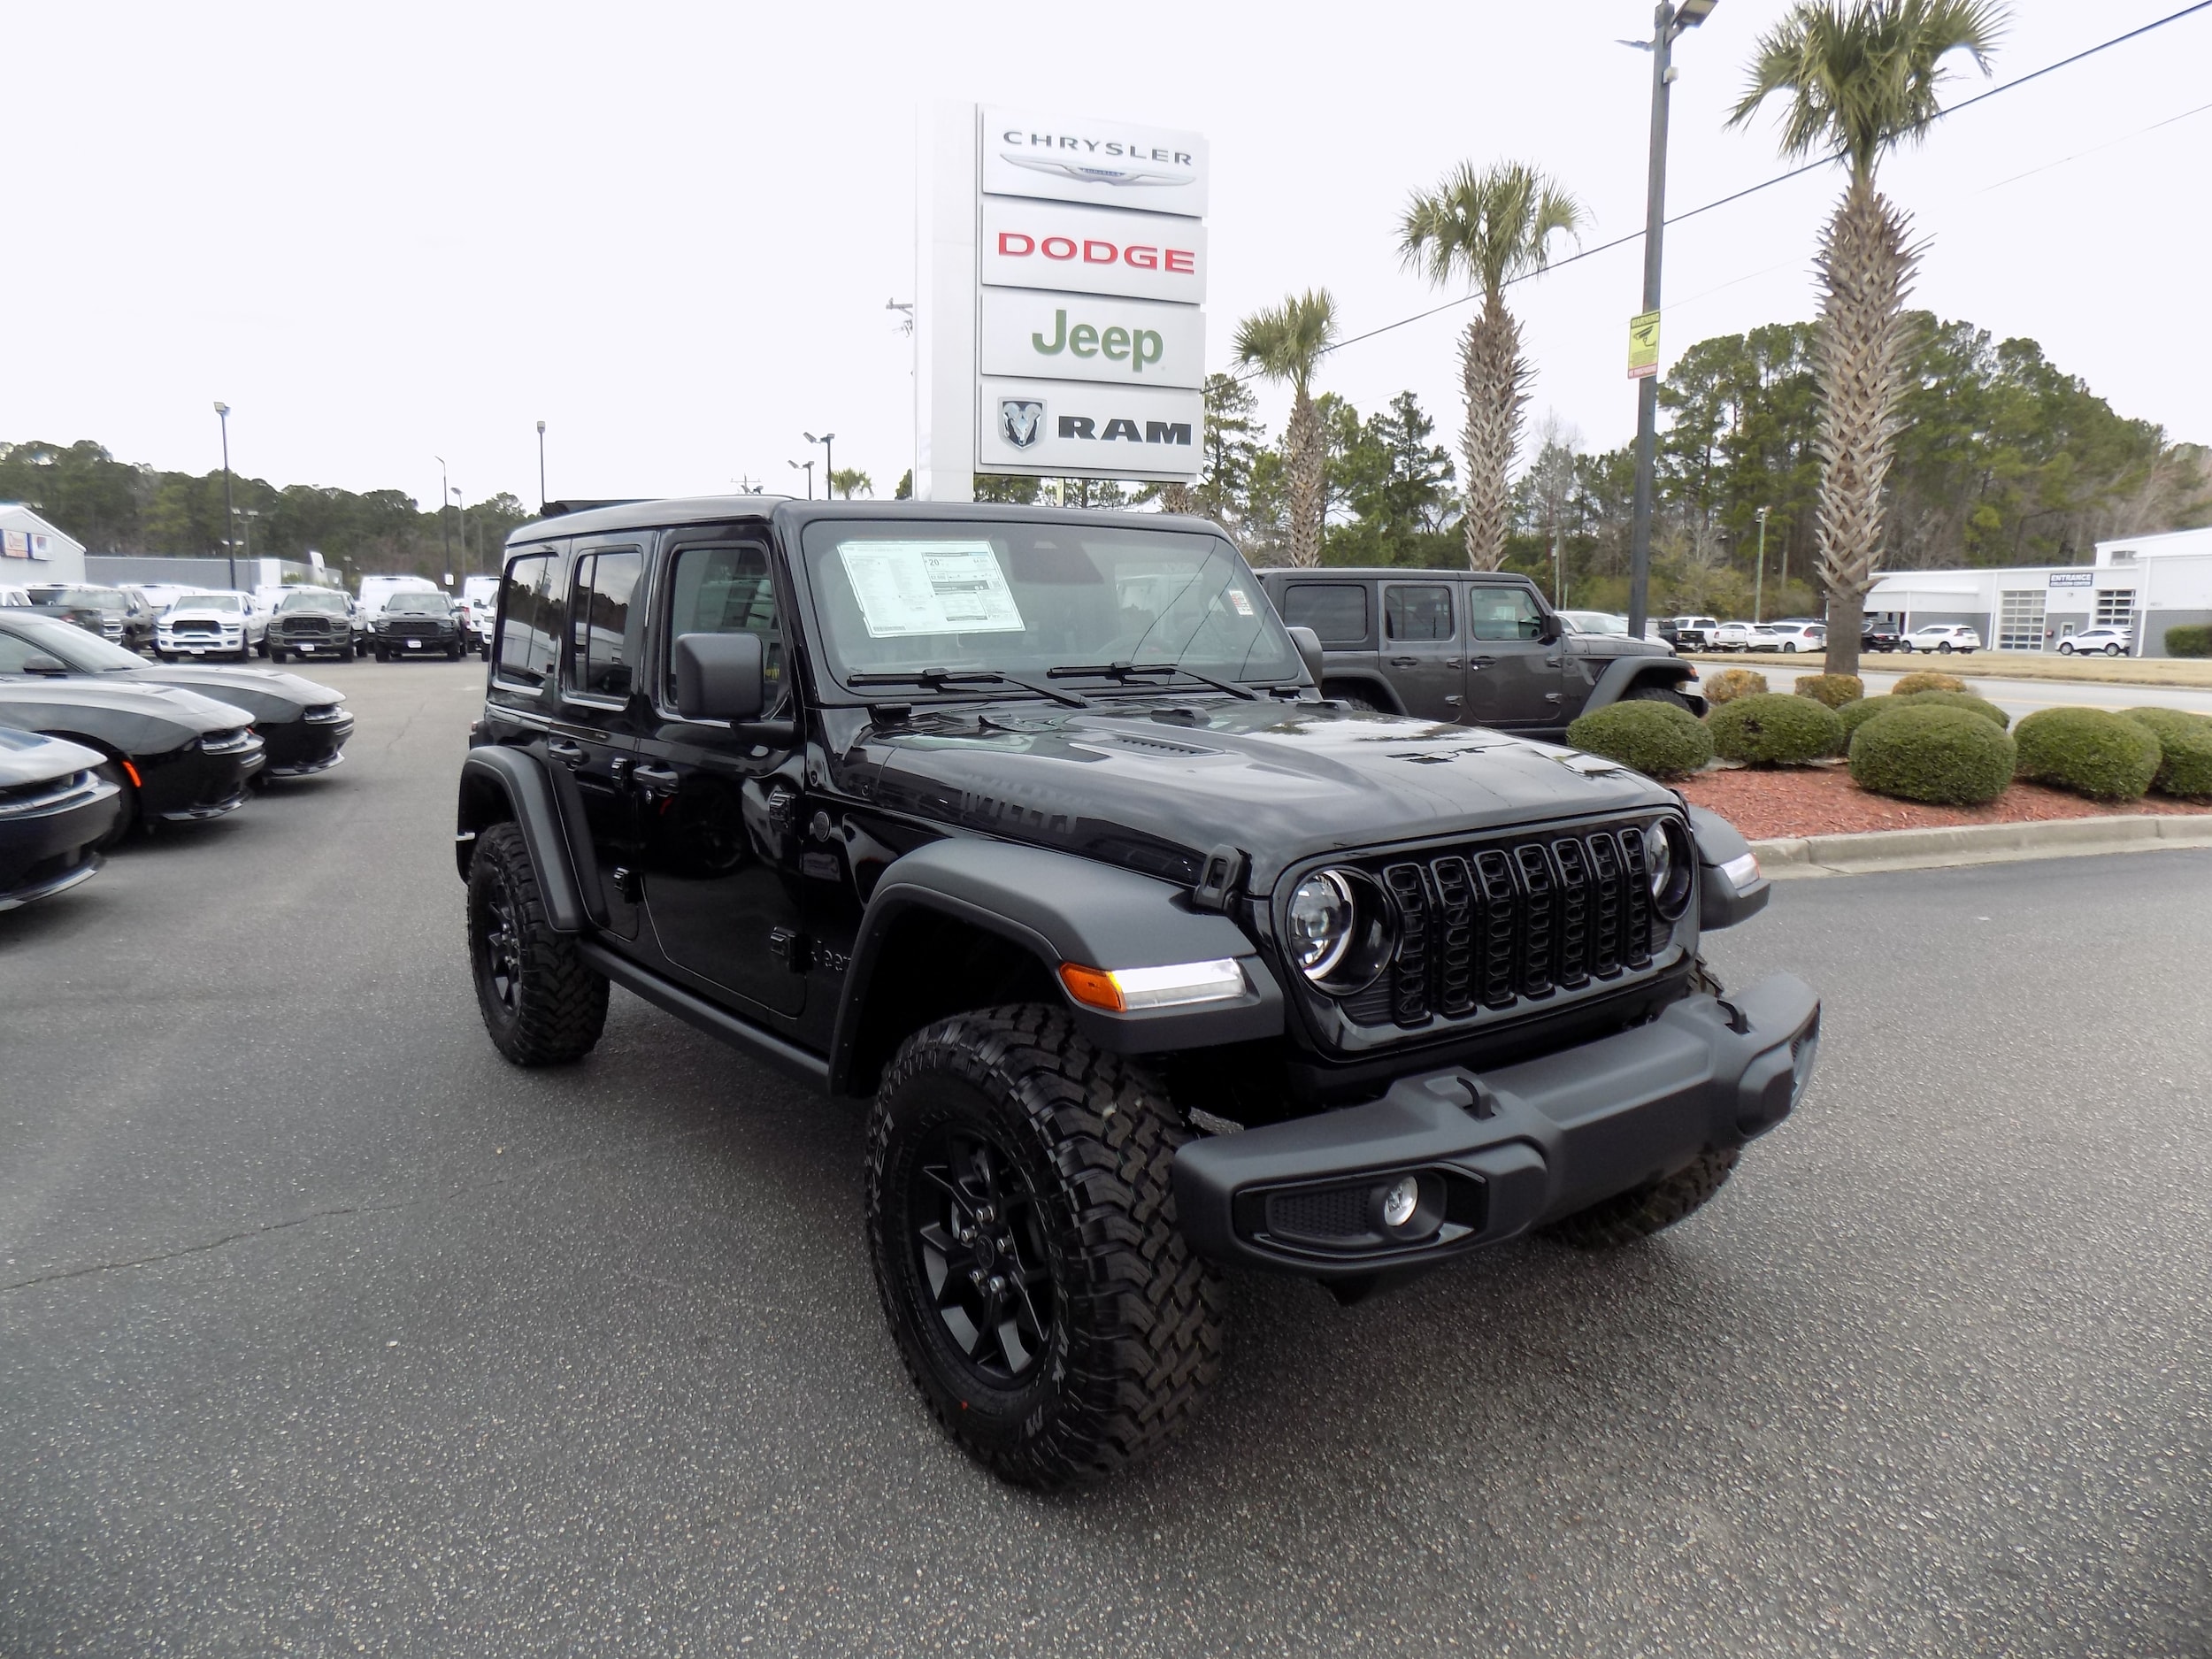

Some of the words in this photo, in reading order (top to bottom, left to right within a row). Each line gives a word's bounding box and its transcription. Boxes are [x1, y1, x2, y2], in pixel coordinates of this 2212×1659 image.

[1003, 131, 1192, 165] CHRYSLER
[998, 233, 1194, 274] DODGE
[1032, 309, 1164, 372] Jeep
[1058, 415, 1192, 445] RAM
